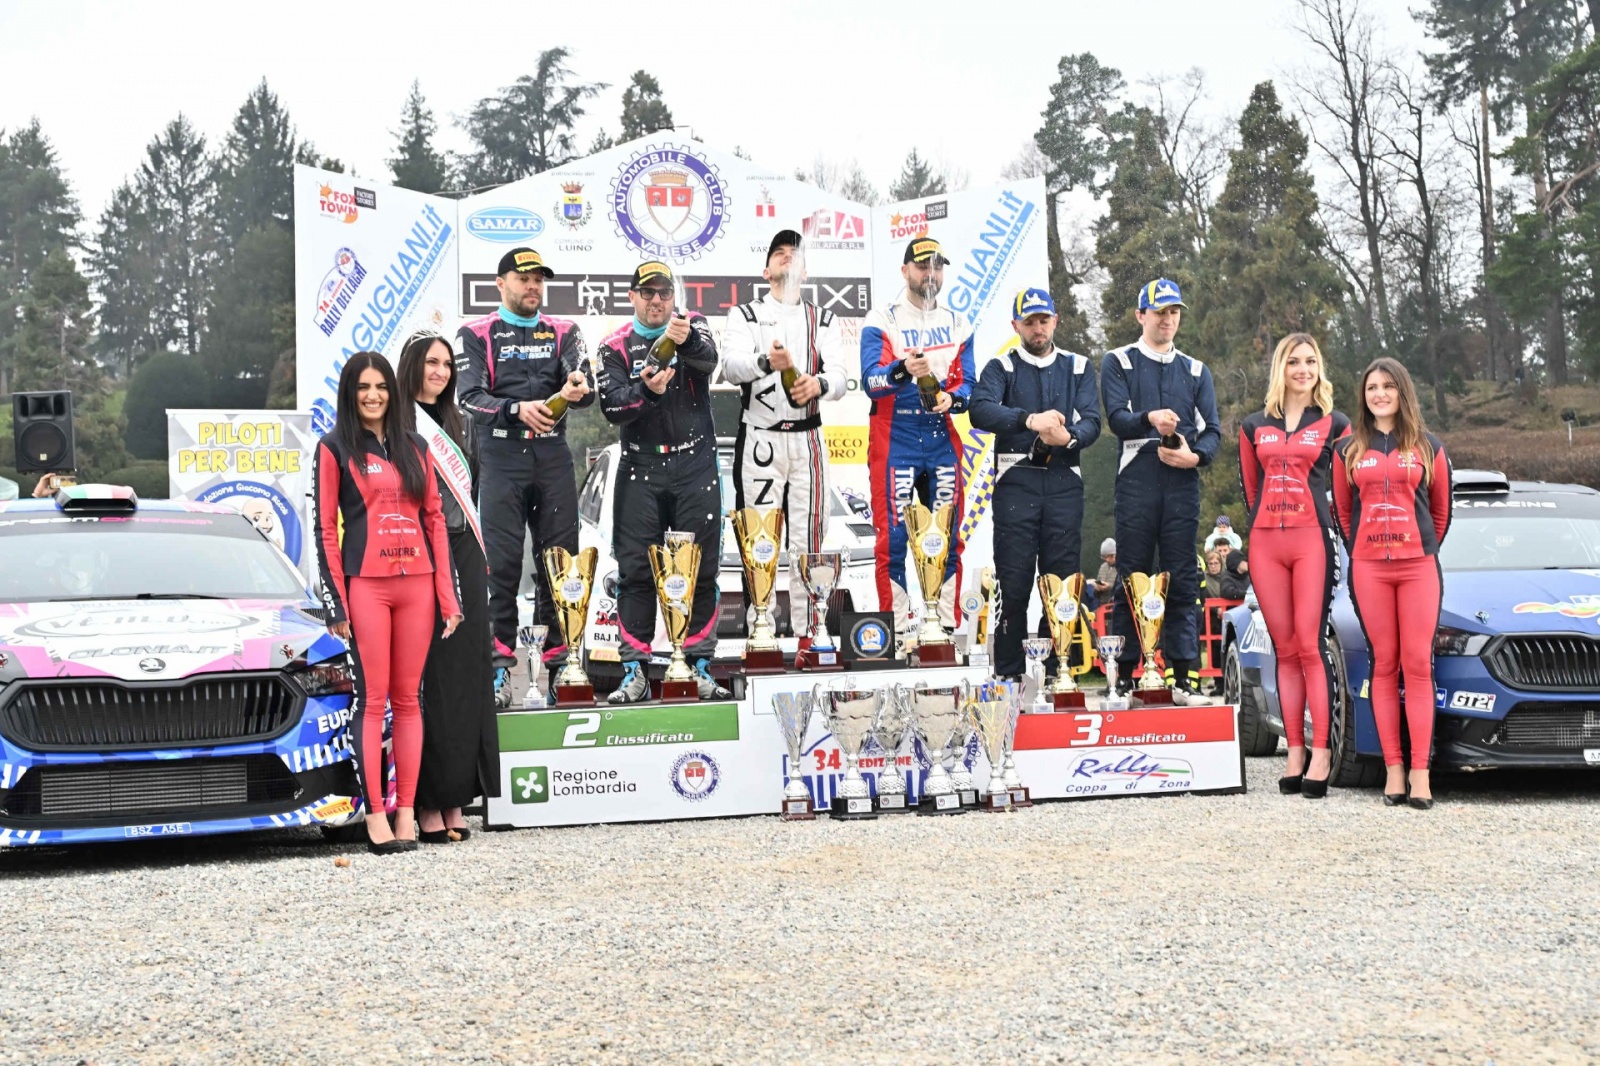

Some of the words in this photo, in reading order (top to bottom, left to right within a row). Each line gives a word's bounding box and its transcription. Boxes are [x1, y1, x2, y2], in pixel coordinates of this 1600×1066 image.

[616, 151, 687, 214] AUTOMOBILE
[703, 172, 722, 217] CLUB
[333, 191, 357, 206] FOX
[320, 200, 357, 216] TOWN
[470, 218, 540, 230] SAMAR
[904, 212, 927, 226] FOX
[890, 223, 928, 239] TOWN
[640, 238, 702, 257] VARESE
[947, 190, 1023, 312] GLIANI.it
[318, 304, 344, 338] RALLY
[198, 421, 282, 446] PILOTI
[824, 438, 863, 448] ICCO
[178, 449, 229, 474] PER
[235, 449, 301, 474] BENE
[431, 432, 452, 457] MISS
[446, 453, 469, 482] RALLY
[1266, 503, 1306, 512] AUTOREX
[1473, 500, 1557, 509] RACING
[1366, 532, 1411, 543] AUTOREX
[379, 547, 421, 558] AUTOREX
[317, 708, 351, 734] EUR
[605, 732, 694, 746] Classificato
[1105, 732, 1186, 746] Classificato
[813, 748, 842, 771] 34
[858, 755, 912, 769] EDIZONE
[1072, 754, 1162, 780] Rally
[552, 770, 618, 785] Regione
[553, 781, 637, 797] Lombardia
[1066, 783, 1108, 794] Coppa
[1125, 781, 1138, 790] di
[1159, 779, 1191, 789] Zona
[315, 801, 350, 819] PIRELLI
